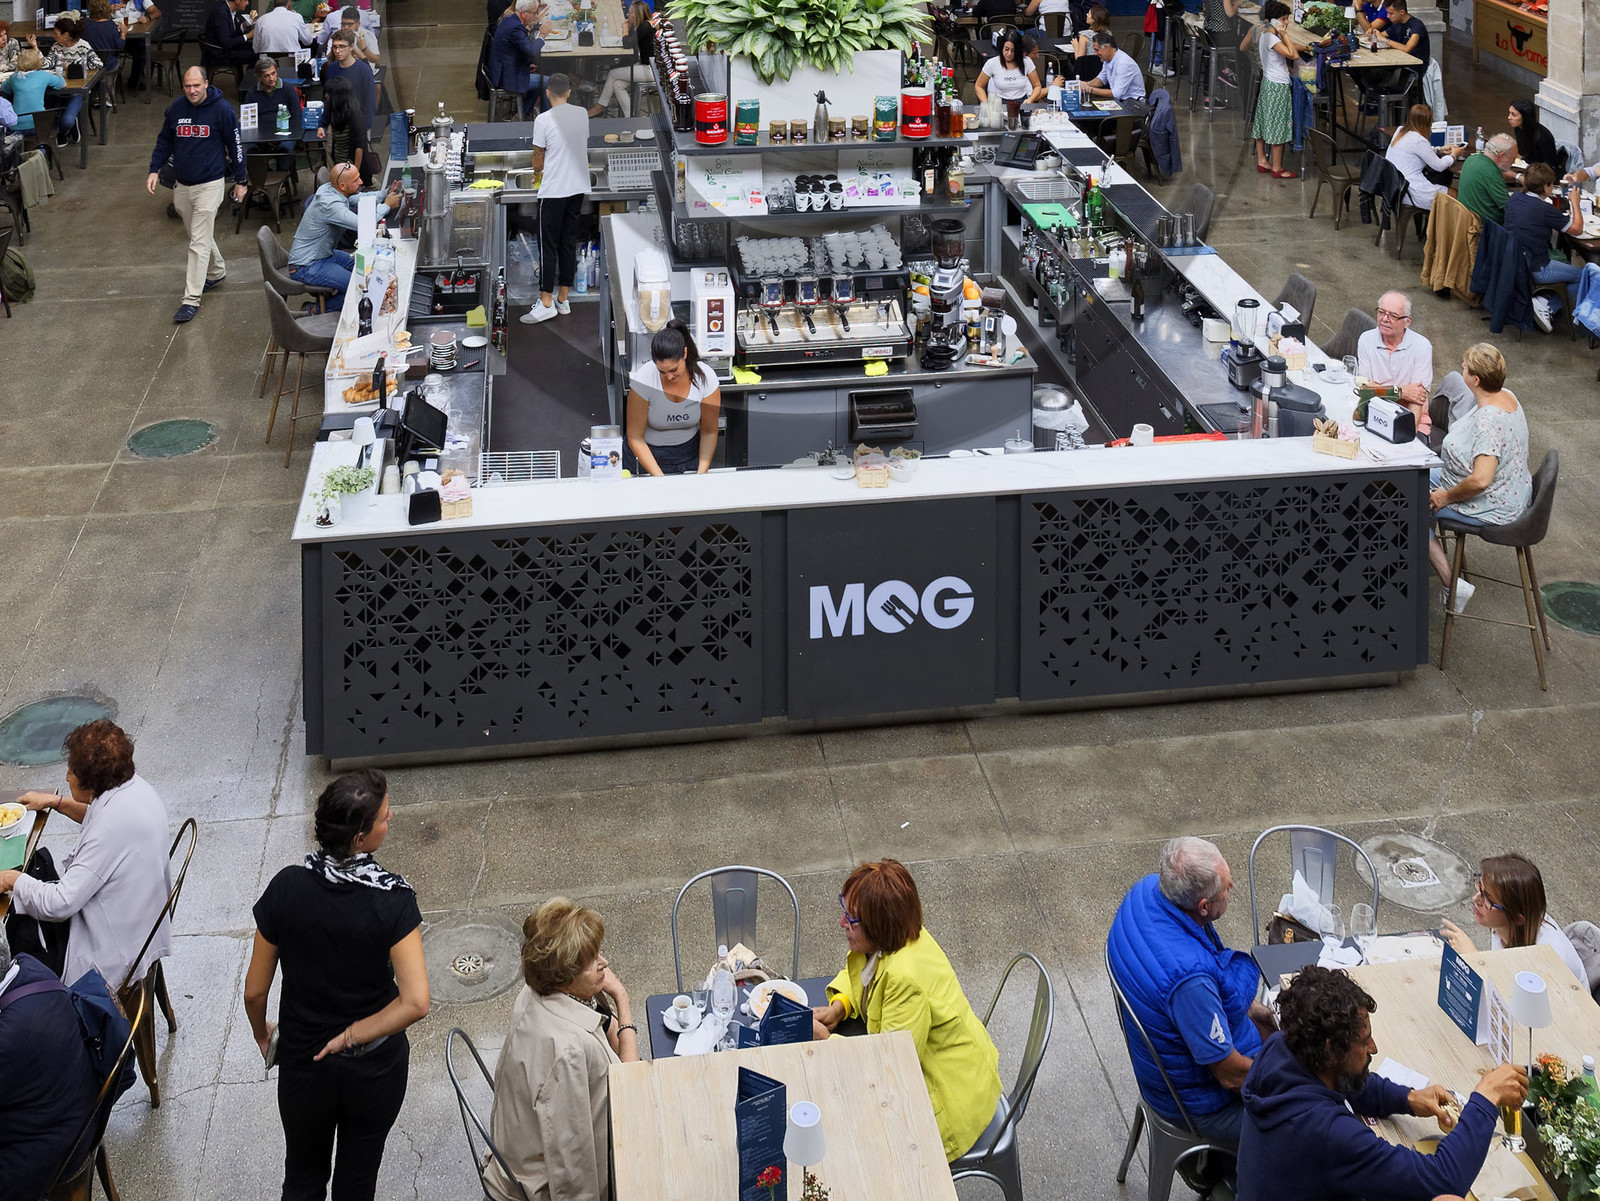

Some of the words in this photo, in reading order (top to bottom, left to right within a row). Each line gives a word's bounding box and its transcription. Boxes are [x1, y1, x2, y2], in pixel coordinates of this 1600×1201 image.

[176, 124, 210, 138] 1893
[666, 413, 690, 422] MOG
[809, 575, 975, 639] MOG
[1209, 1012, 1226, 1044] 4
